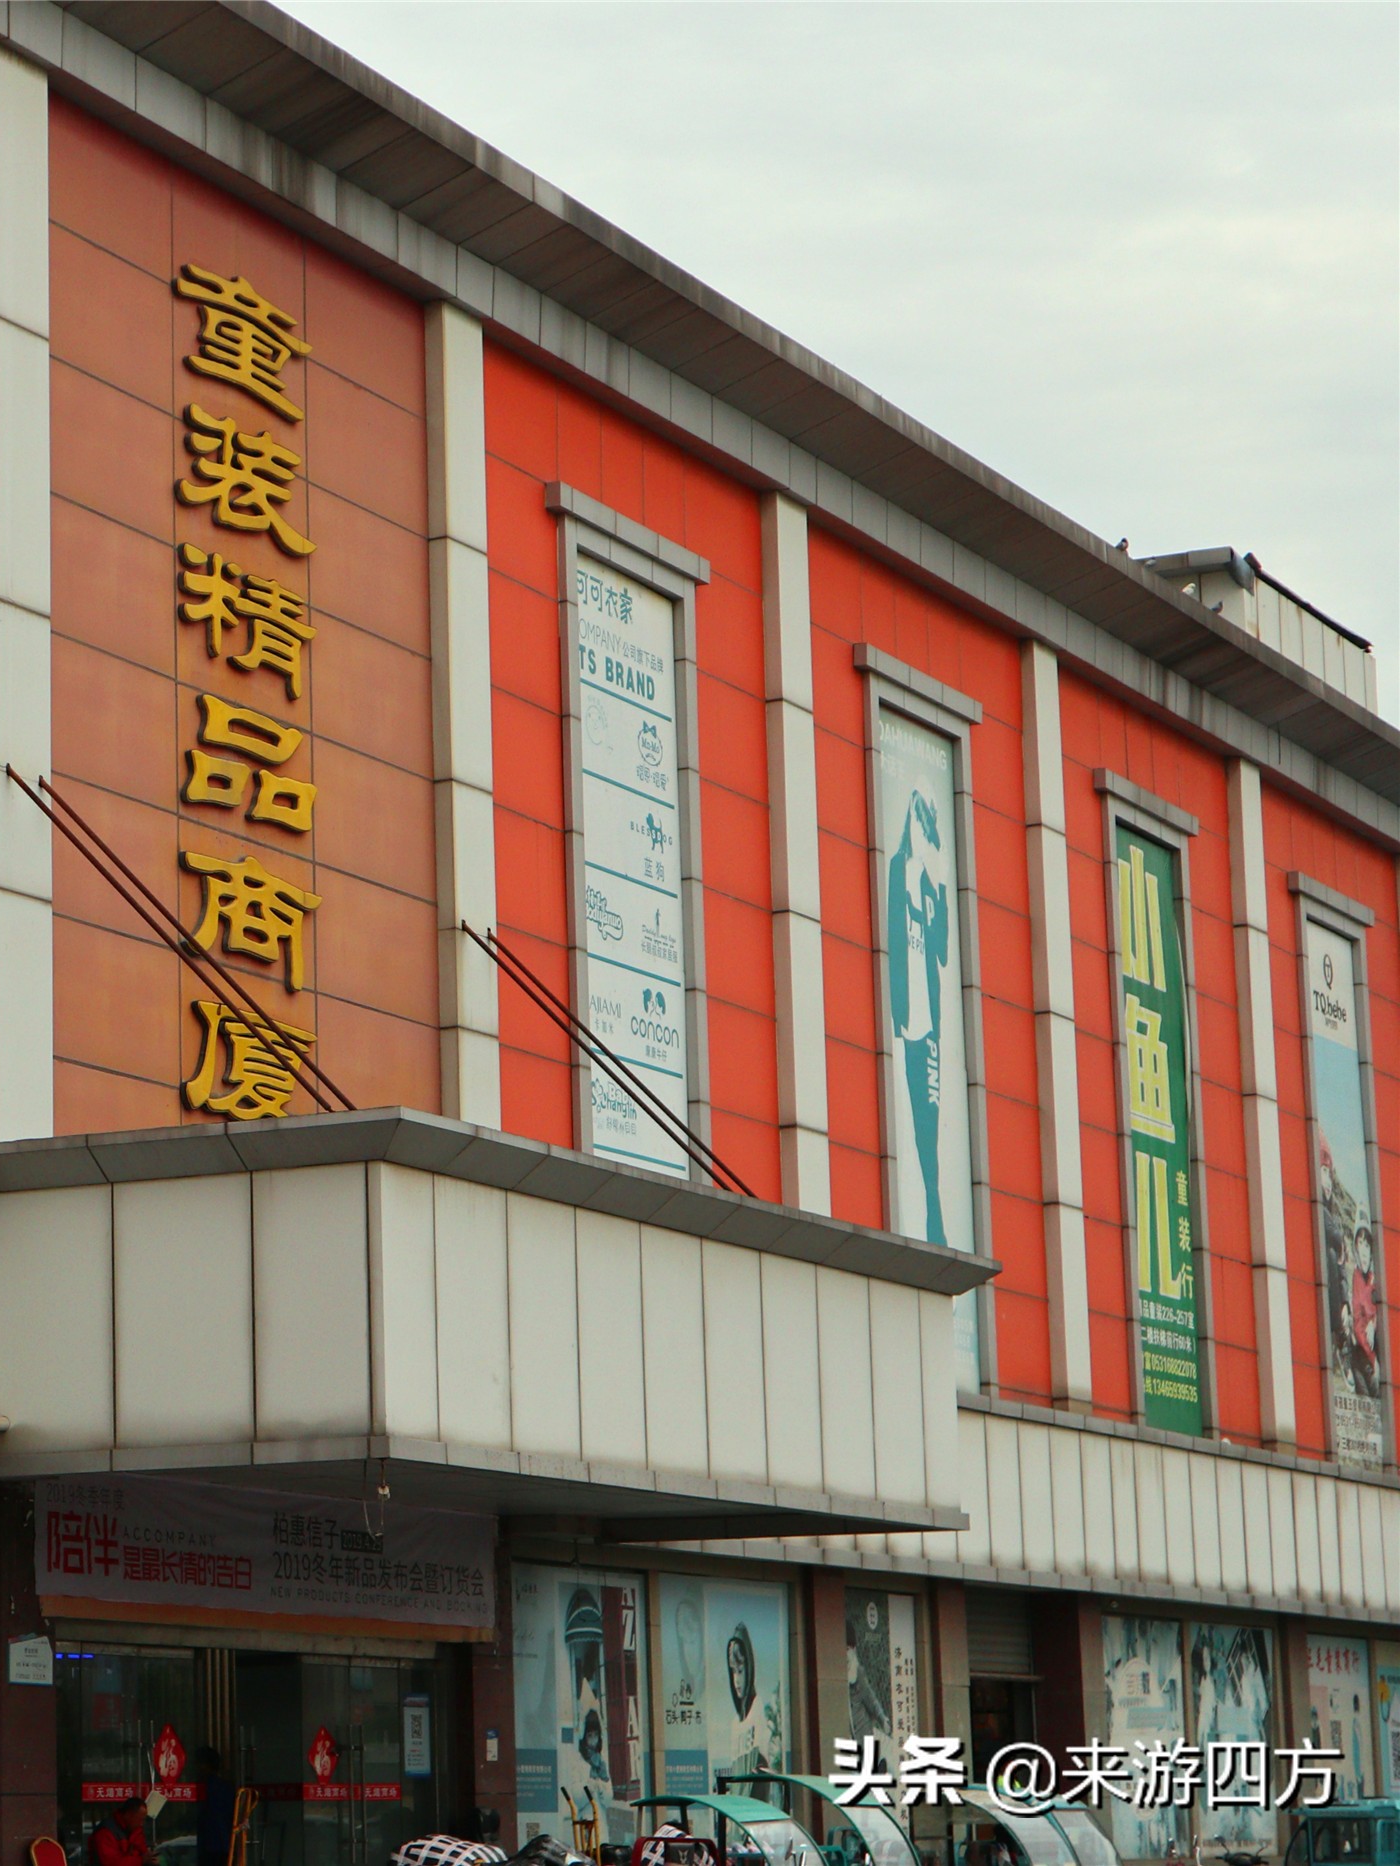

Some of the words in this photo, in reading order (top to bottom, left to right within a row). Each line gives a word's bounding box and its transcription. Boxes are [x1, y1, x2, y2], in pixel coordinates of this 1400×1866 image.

[171, 262, 322, 1121] 童装精品商厦
[605, 656, 655, 701] BRAND
[47, 1510, 119, 1576] 陪伴
[123, 1526, 216, 1548] ACCOMPANY
[273, 1512, 339, 1549] 柏惠信子
[123, 1545, 252, 1590] 是最长情的告白
